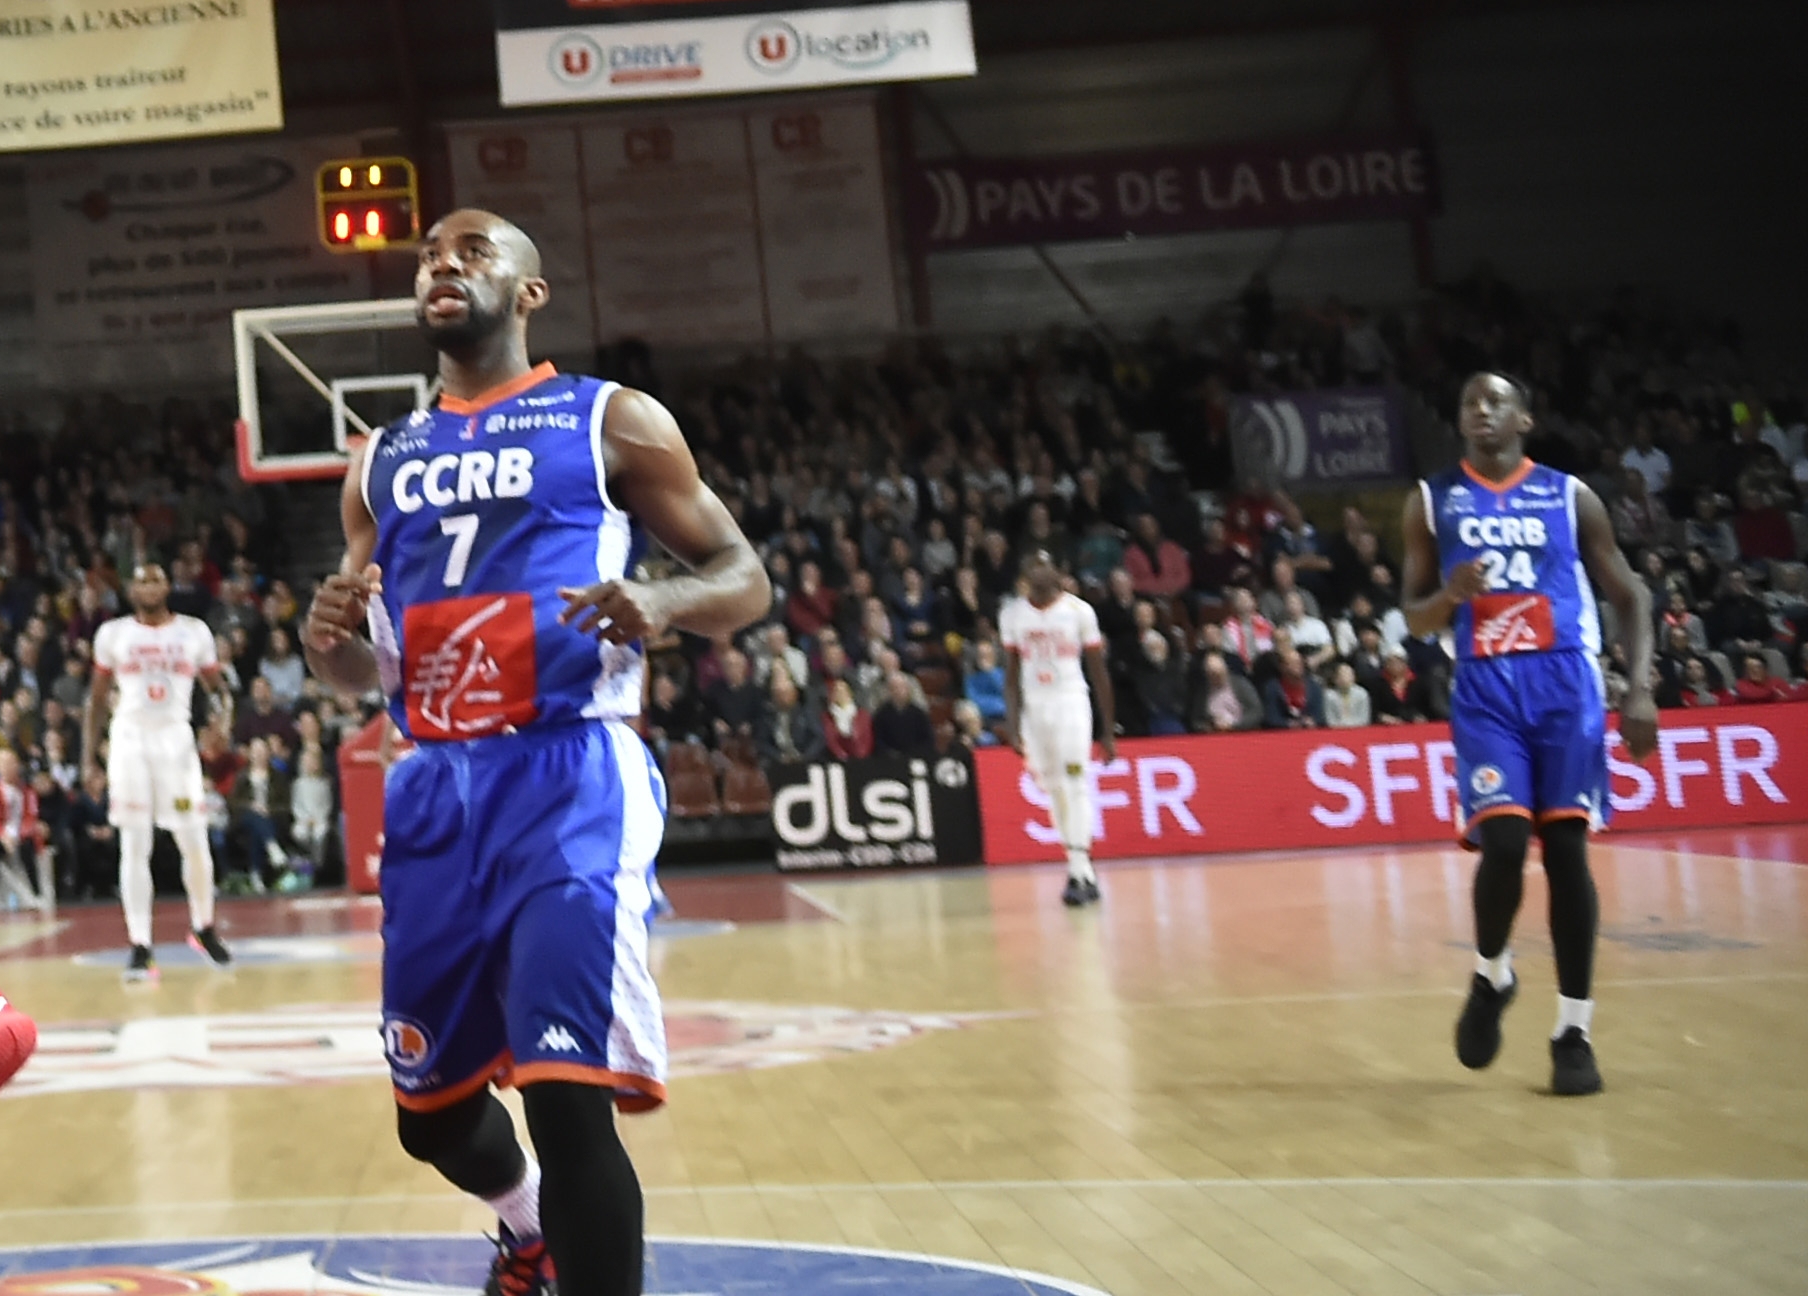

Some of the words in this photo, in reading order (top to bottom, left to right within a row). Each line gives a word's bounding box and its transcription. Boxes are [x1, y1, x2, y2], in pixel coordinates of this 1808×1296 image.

[609, 40, 705, 71] DRIVE
[805, 26, 931, 57] location
[3, 75, 89, 101] rayons
[95, 65, 188, 92] traiteur
[35, 106, 64, 129] de
[73, 105, 137, 127] votre
[975, 173, 1102, 223] PAYS
[1115, 168, 1185, 219] DE
[1198, 160, 1266, 208] LA
[1278, 147, 1428, 203] LOIRE
[392, 446, 534, 515] CCRB
[439, 513, 480, 587] 7
[1458, 516, 1548, 548] CCRB
[1478, 549, 1539, 590] 24
[773, 758, 935, 848] dlsi
